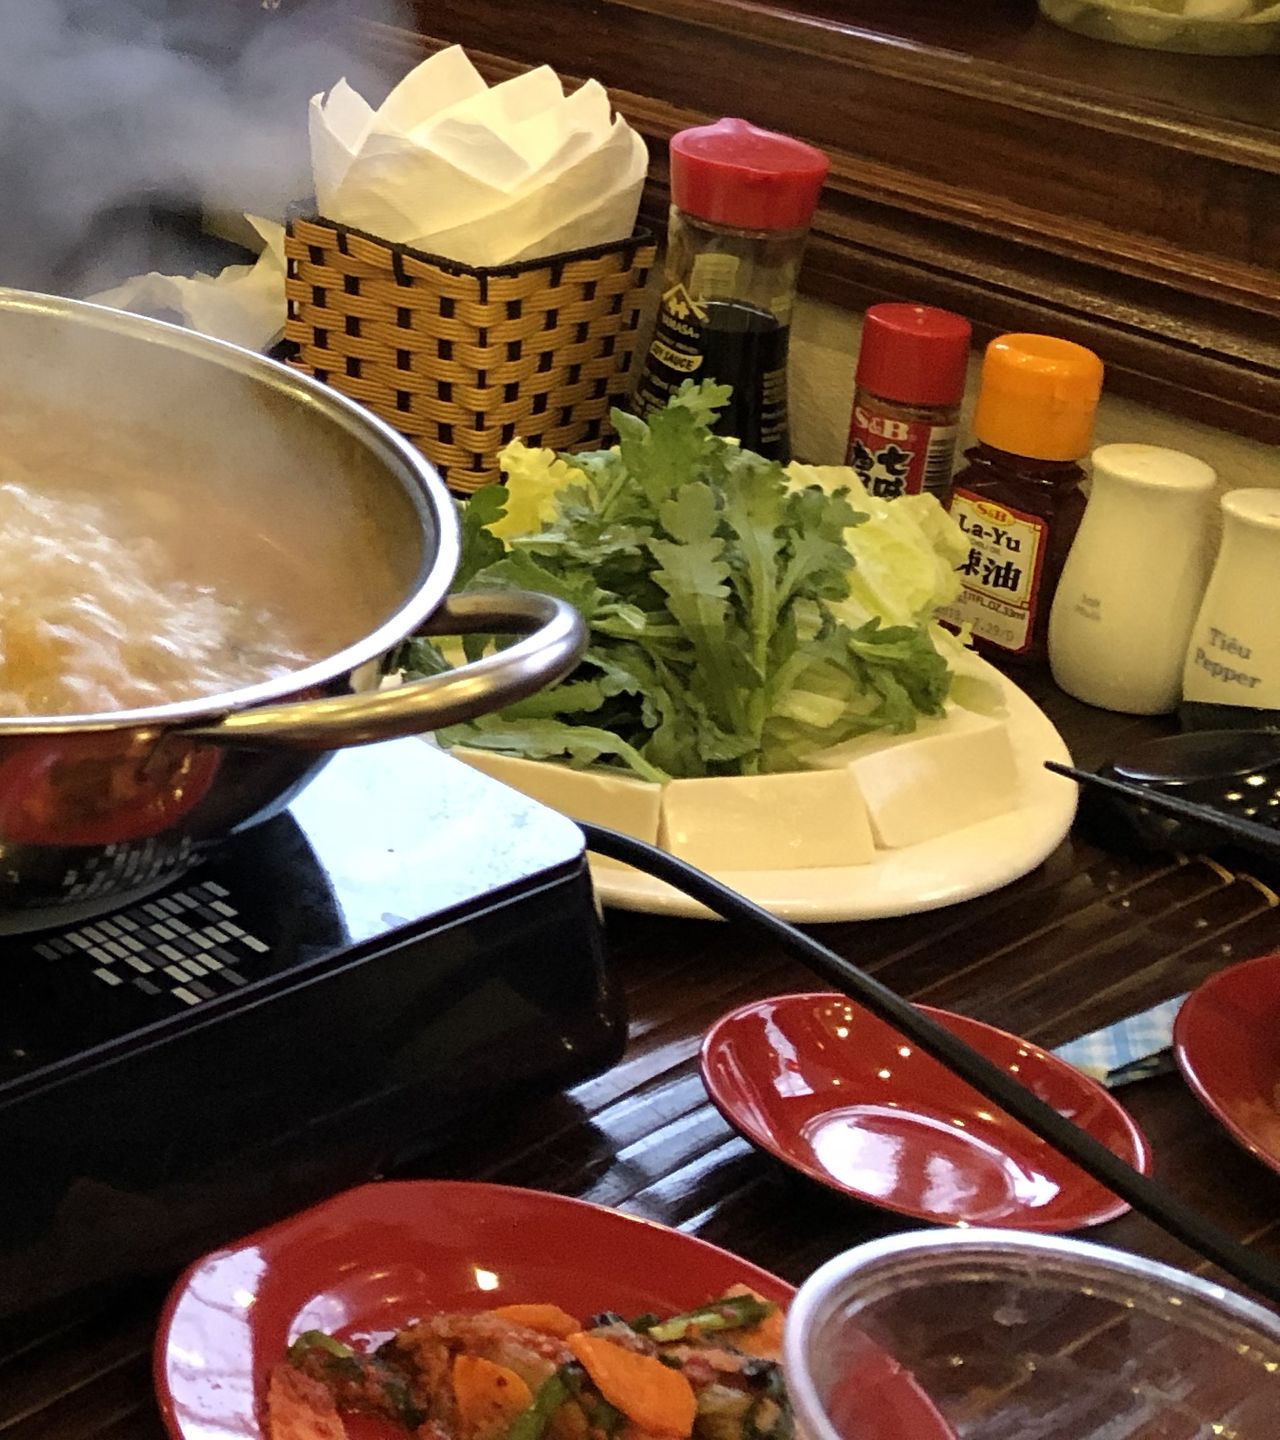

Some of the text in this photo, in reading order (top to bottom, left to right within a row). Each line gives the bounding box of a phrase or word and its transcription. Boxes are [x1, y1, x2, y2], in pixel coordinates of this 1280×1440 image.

[854, 406, 910, 441] S&B
[958, 513, 1022, 553] La-Yu
[1195, 647, 1263, 689] Pepper
